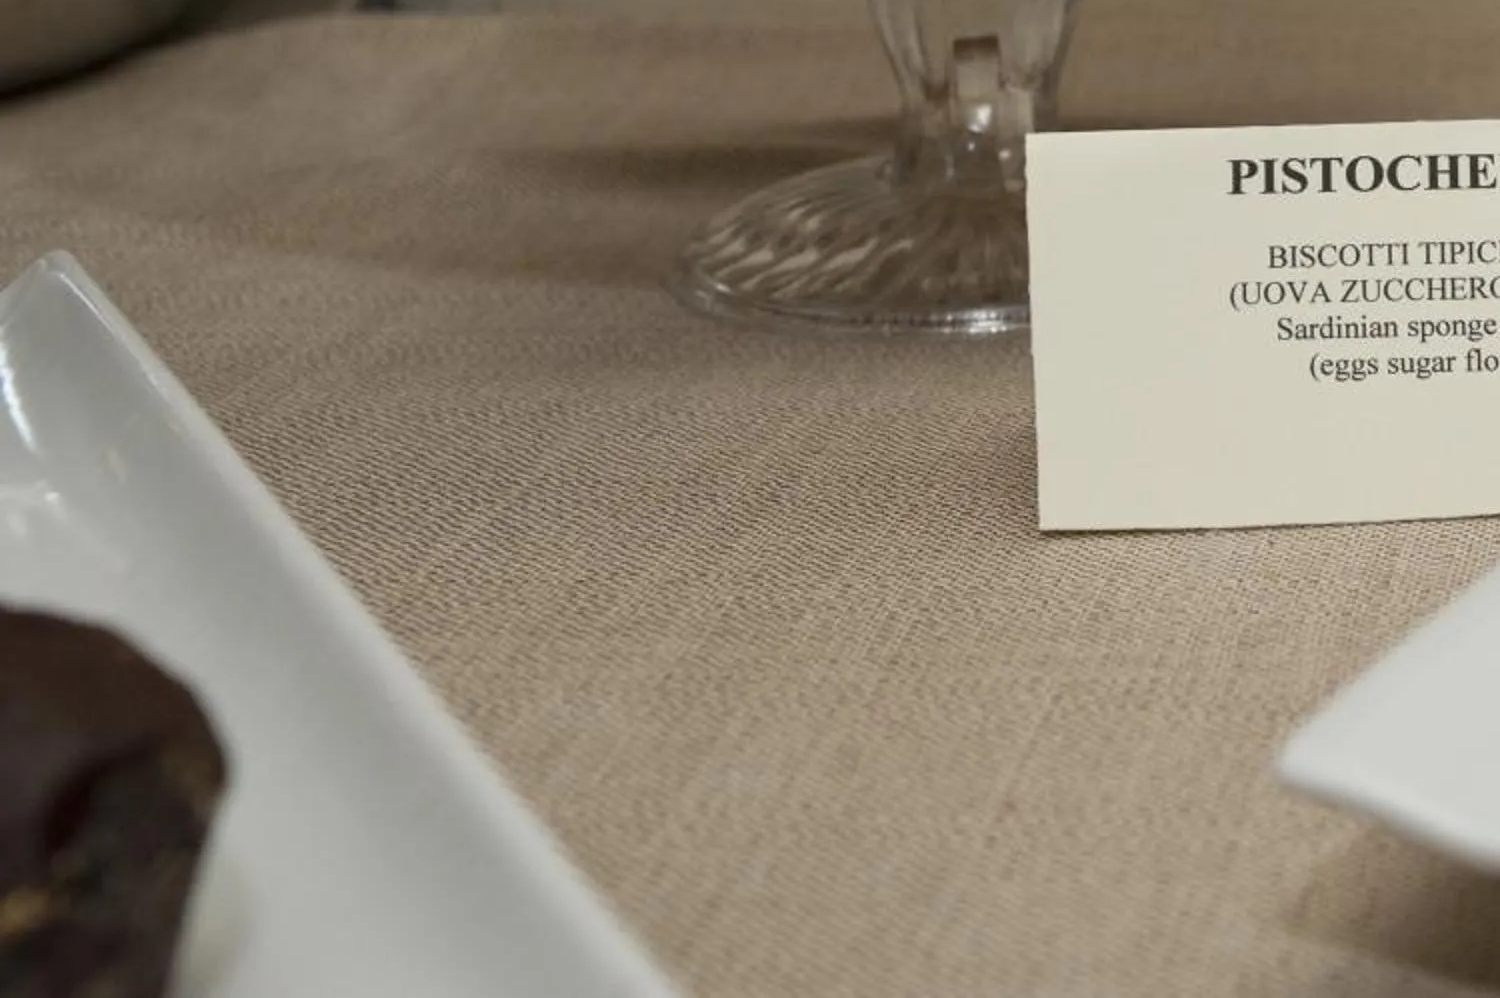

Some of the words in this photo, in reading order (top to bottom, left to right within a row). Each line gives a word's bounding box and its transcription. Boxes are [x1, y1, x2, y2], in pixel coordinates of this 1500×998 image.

[1268, 242, 1409, 269] BISCOTTI
[1229, 280, 1331, 310] (UOVA
[1276, 315, 1399, 341] Sardinian
[1406, 317, 1497, 343] sponge
[1309, 354, 1379, 382] (eggs
[1387, 355, 1457, 379] sugar
